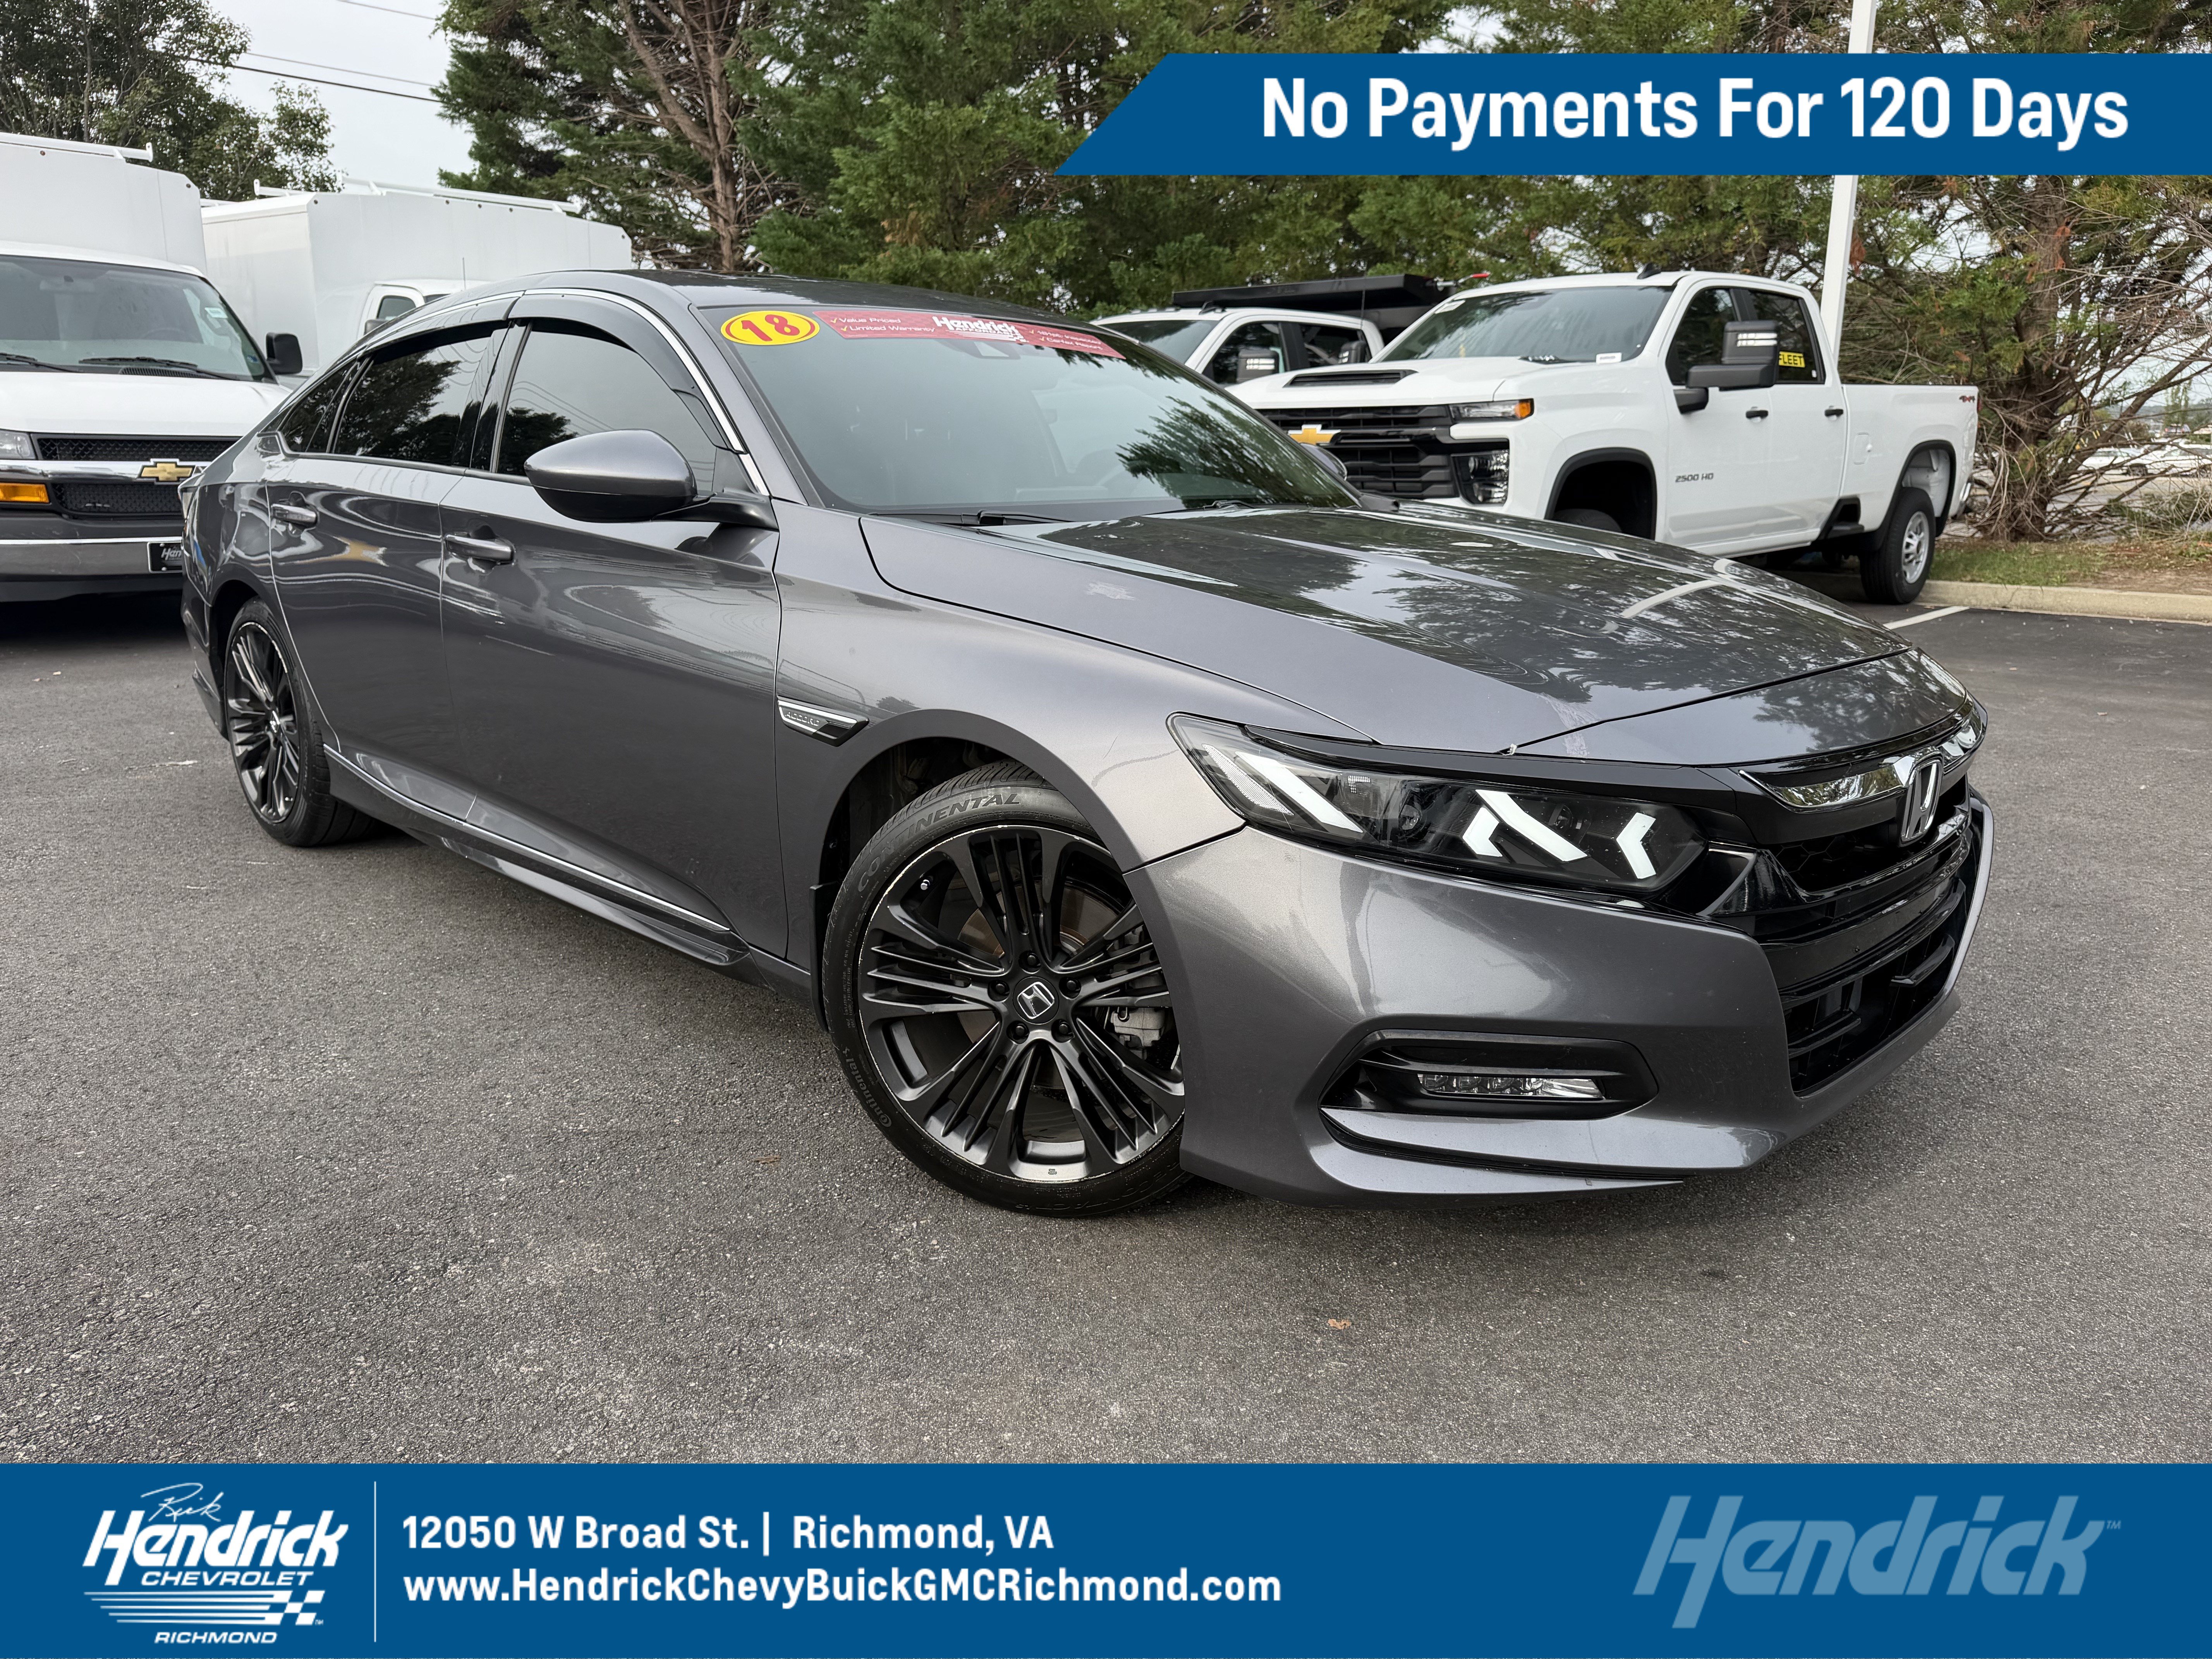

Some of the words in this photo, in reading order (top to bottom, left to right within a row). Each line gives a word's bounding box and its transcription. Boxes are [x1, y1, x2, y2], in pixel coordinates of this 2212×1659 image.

[741, 314, 800, 341] 18
[932, 316, 1019, 333] Hendrick
[1675, 474, 1699, 483] 2500
[858, 794, 1020, 892] CONTINENTAL
